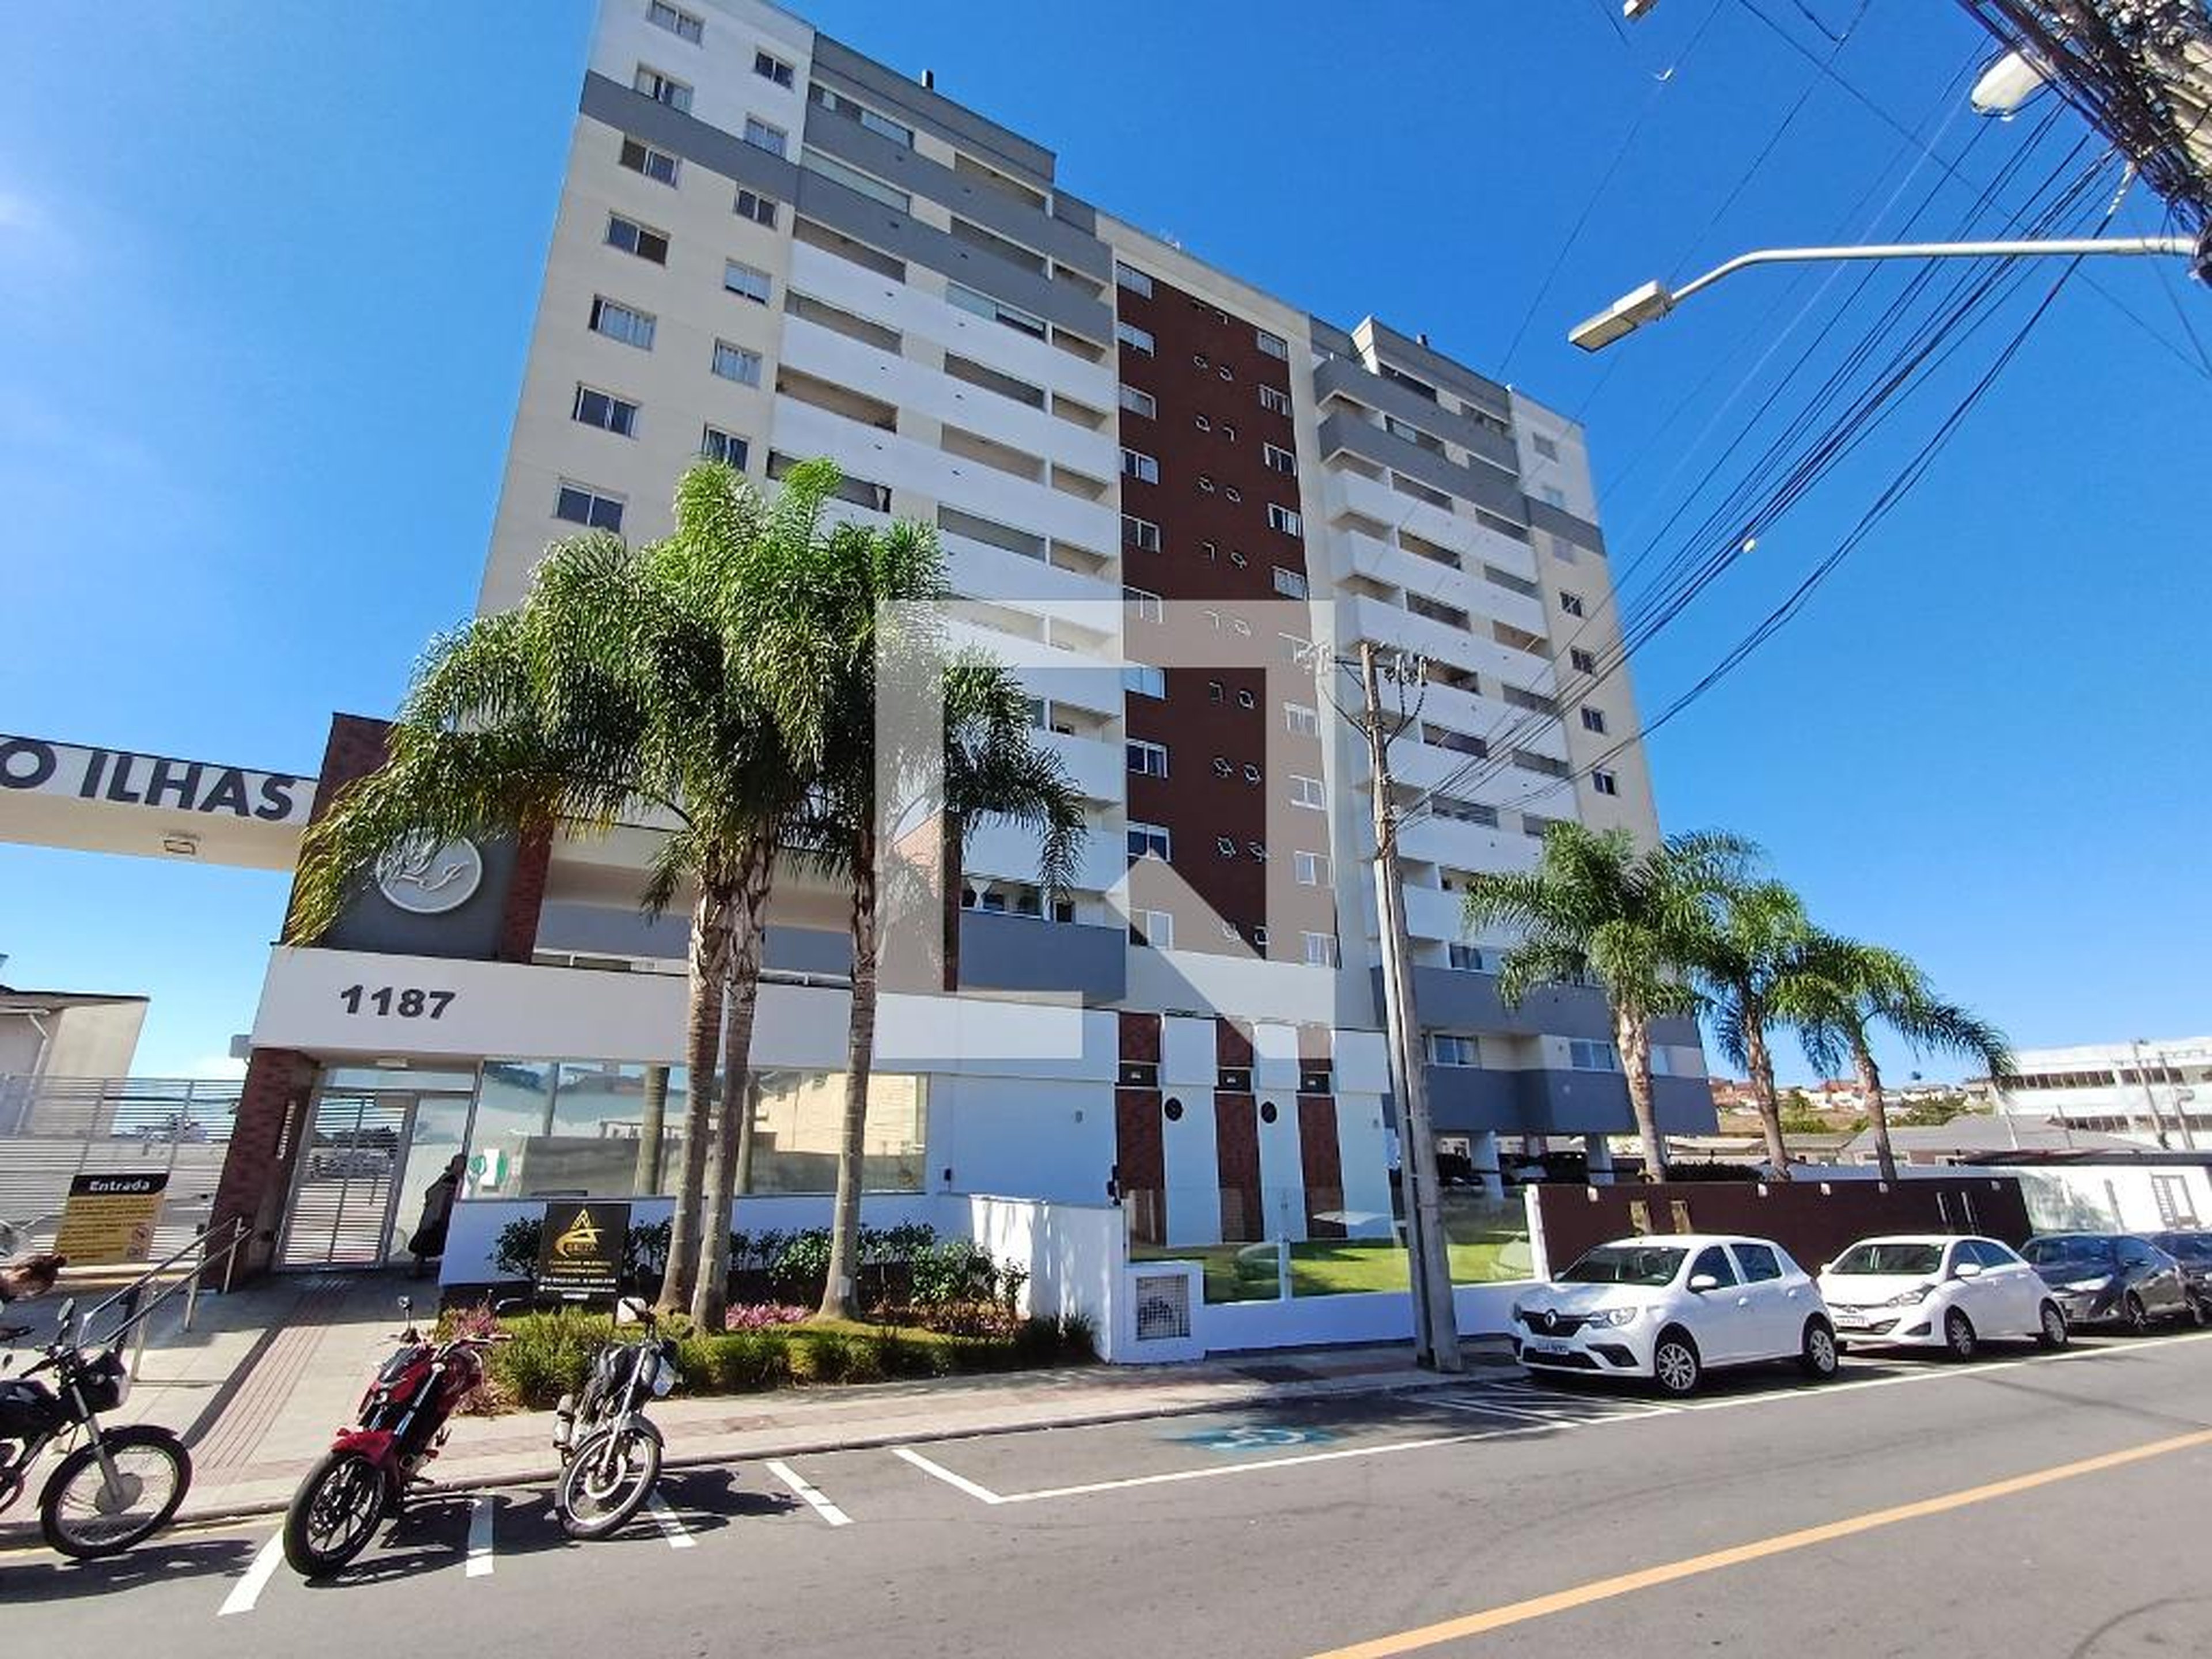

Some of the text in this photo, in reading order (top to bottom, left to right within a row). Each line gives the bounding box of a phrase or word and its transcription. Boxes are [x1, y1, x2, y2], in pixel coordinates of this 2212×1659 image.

[79, 751, 293, 821] ILHAS
[340, 985, 456, 1020] 1187
[89, 1180, 150, 1191] Entrada
